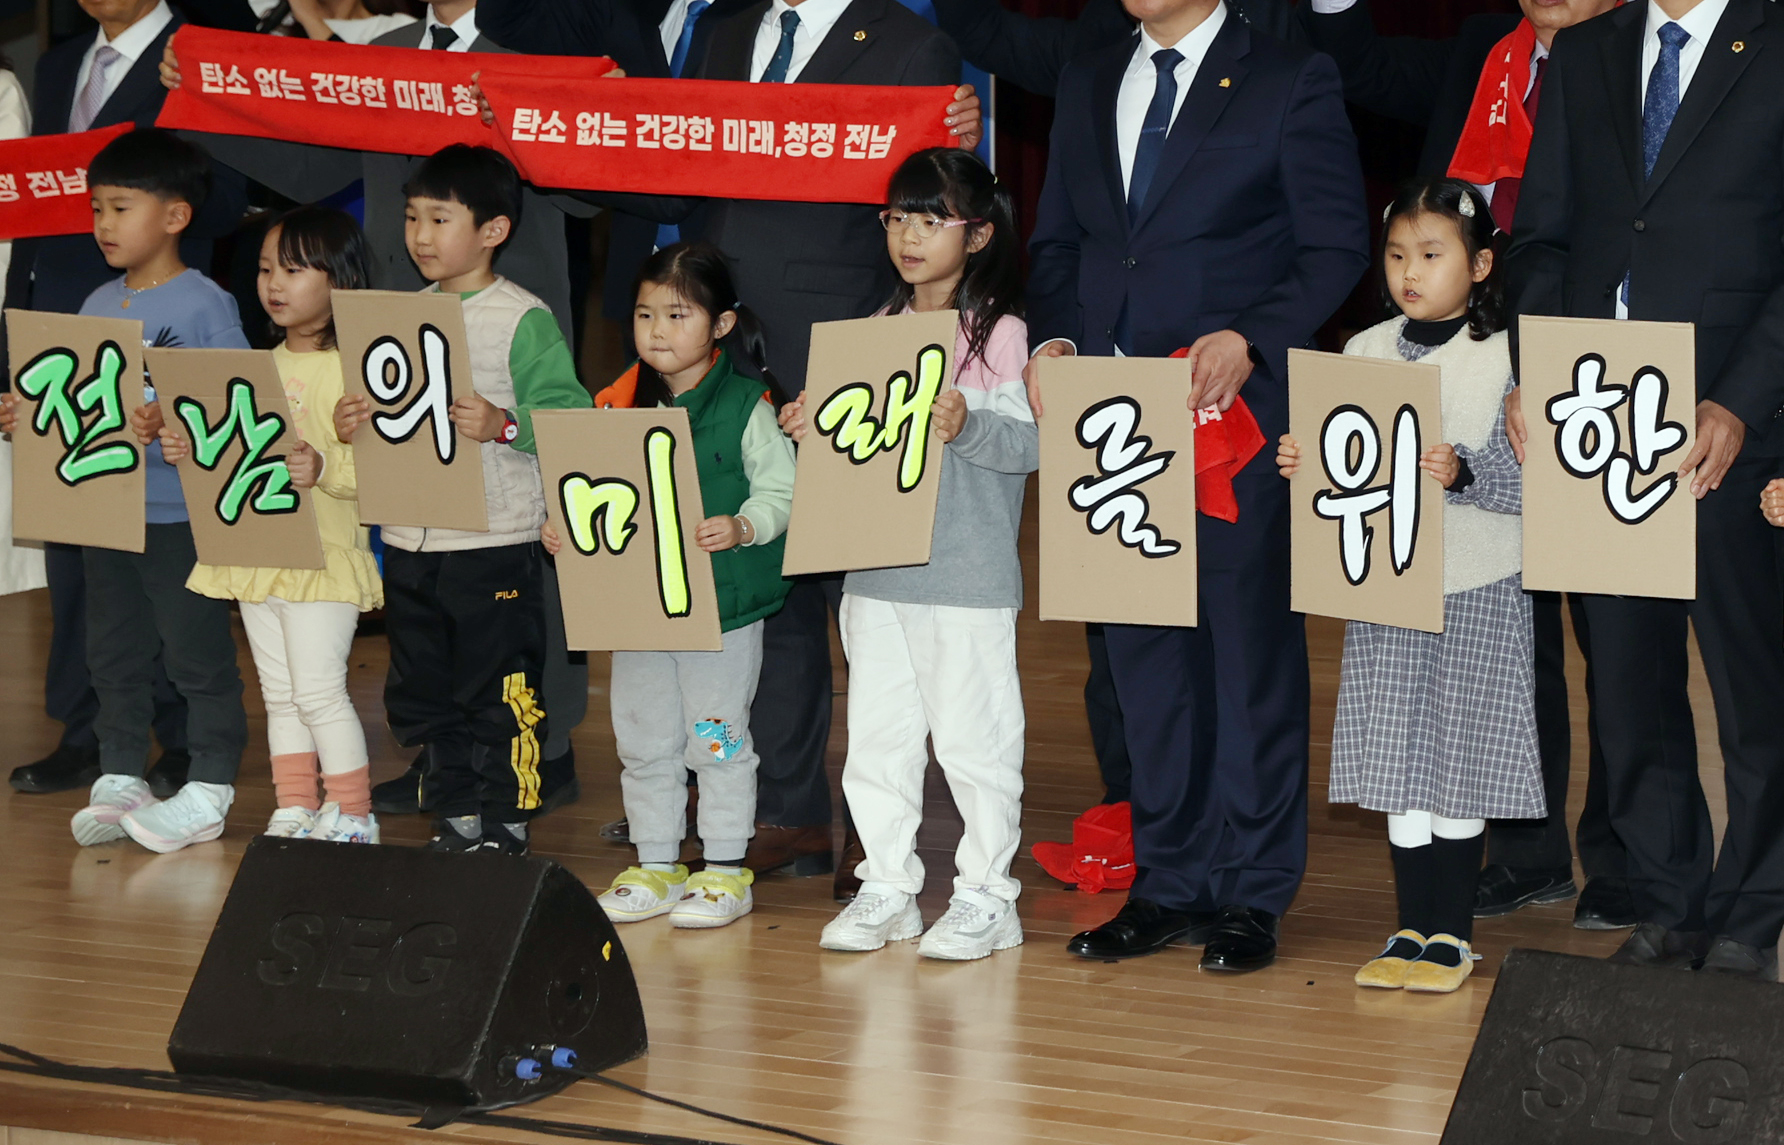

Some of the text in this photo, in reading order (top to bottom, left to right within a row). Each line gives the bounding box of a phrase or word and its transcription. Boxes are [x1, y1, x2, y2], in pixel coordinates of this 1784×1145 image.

[199, 61, 251, 97] 탄소
[254, 68, 306, 104] 없는
[310, 72, 387, 109] 건강한
[512, 107, 566, 144] 탄소
[576, 111, 627, 147] 없는
[635, 114, 714, 152] 건강한
[843, 123, 896, 160] 전남
[25, 167, 87, 199] 전남
[16, 340, 139, 487] 전
[174, 377, 300, 525] 남
[362, 323, 453, 464] 의
[815, 344, 946, 492] 래
[1546, 353, 1687, 524] 한
[559, 425, 691, 617] 미
[1068, 396, 1181, 557] 를
[1314, 403, 1421, 585] 위
[495, 589, 519, 601] FILA
[257, 909, 458, 997] SEG
[1521, 1036, 1751, 1143] SEG
